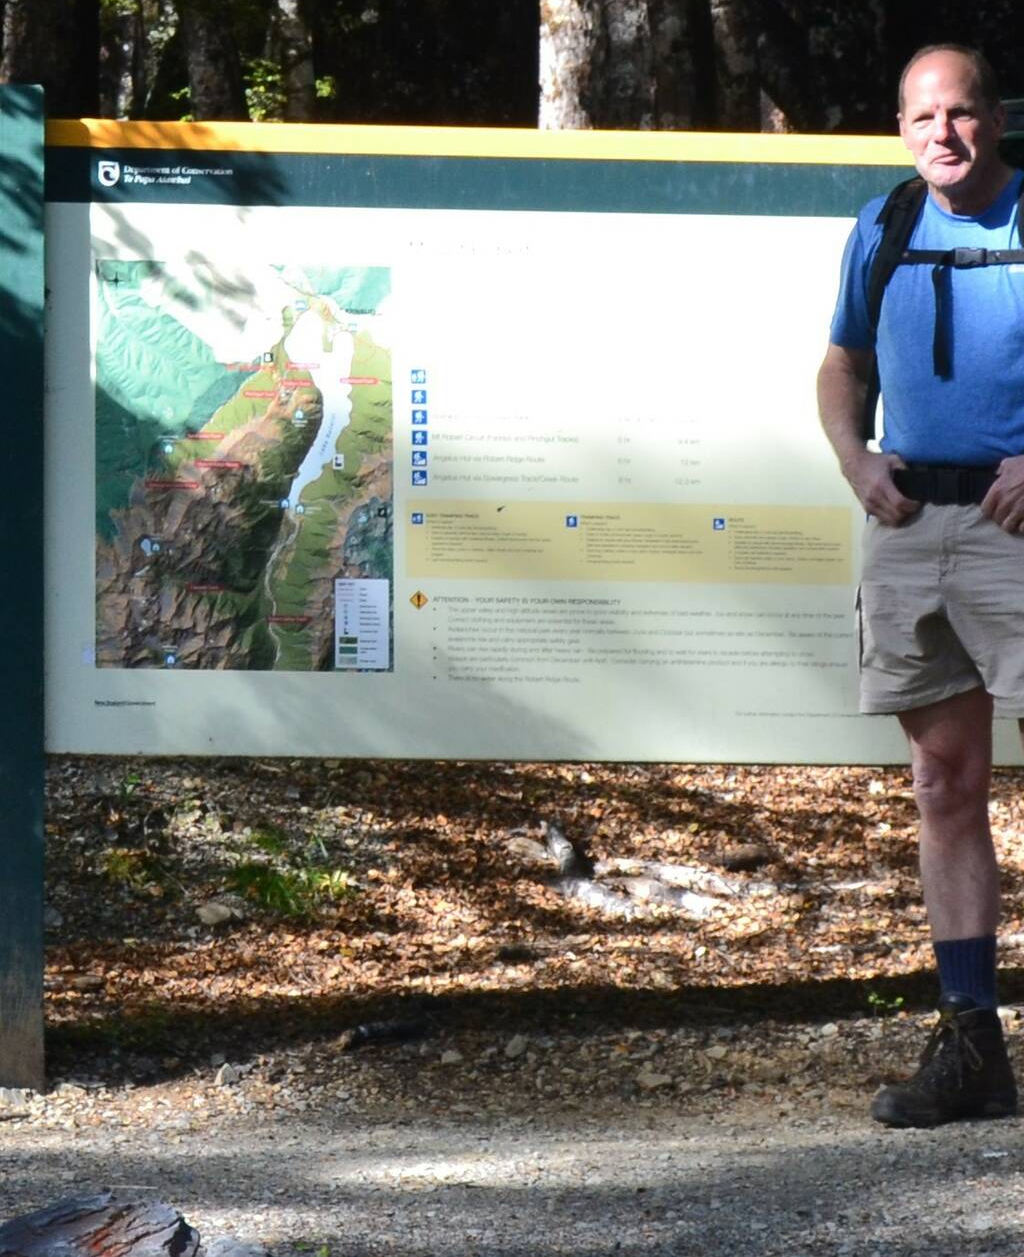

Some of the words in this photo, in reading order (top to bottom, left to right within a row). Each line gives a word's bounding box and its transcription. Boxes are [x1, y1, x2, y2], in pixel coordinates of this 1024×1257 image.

[124, 165, 170, 175] Department
[172, 165, 180, 175] of
[182, 165, 232, 175] Conservation
[124, 175, 134, 184] Te
[134, 175, 154, 184] Papa
